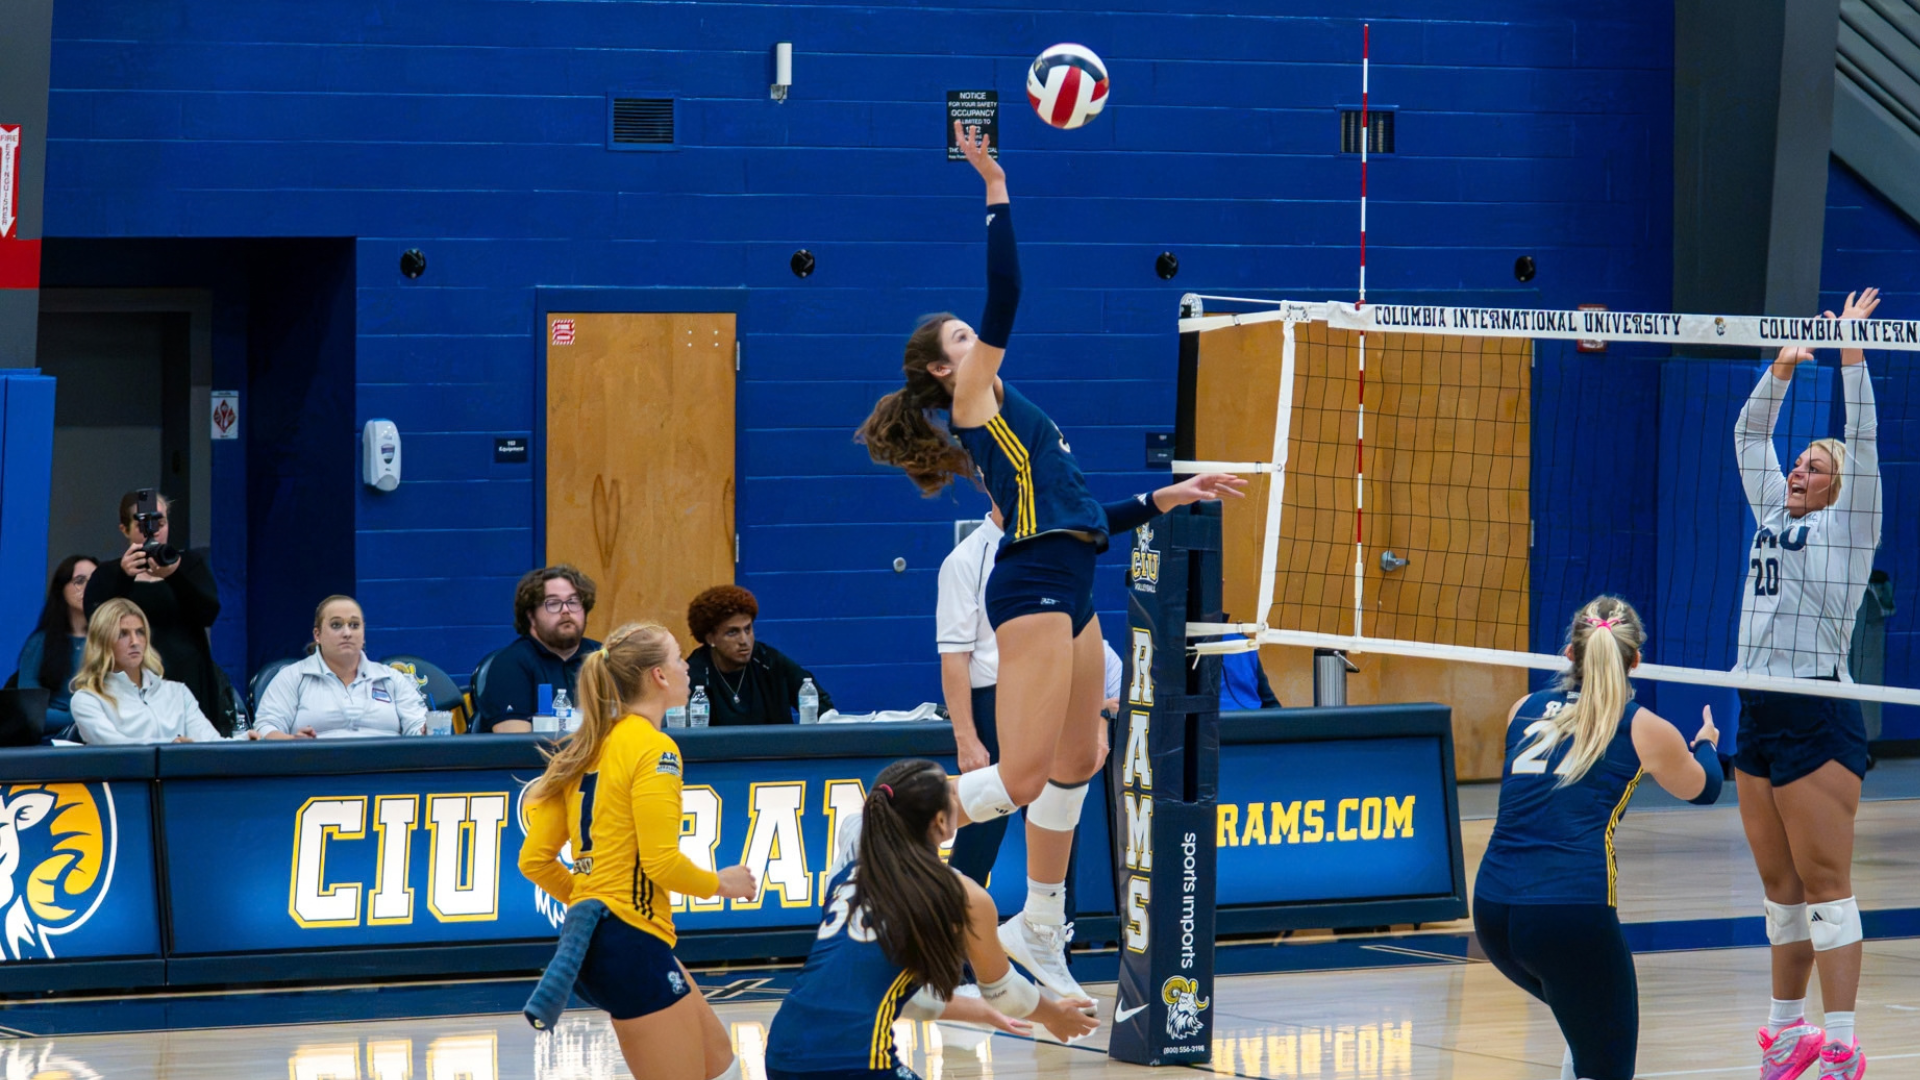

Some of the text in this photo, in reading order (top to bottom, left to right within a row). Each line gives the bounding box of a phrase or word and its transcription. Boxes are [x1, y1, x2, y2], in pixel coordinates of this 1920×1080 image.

[951, 109, 995, 117] OCCUPANCY
[0, 134, 17, 142] FIRE
[2, 143, 10, 226] EXTINGUISHER
[1374, 306, 1682, 336] COLUMBIA INTERNATIONAL UNIVERSITY
[1759, 318, 1920, 343] COLUMBIA INTERN
[1131, 548, 1160, 583] CIU
[1751, 558, 1779, 596] 20
[1123, 627, 1154, 954] RAMS
[1217, 795, 1416, 848] RAMS.COM
[288, 791, 509, 929] CIU
[1180, 832, 1197, 969] sports imports
[1163, 1047, 1178, 1055] (800)
